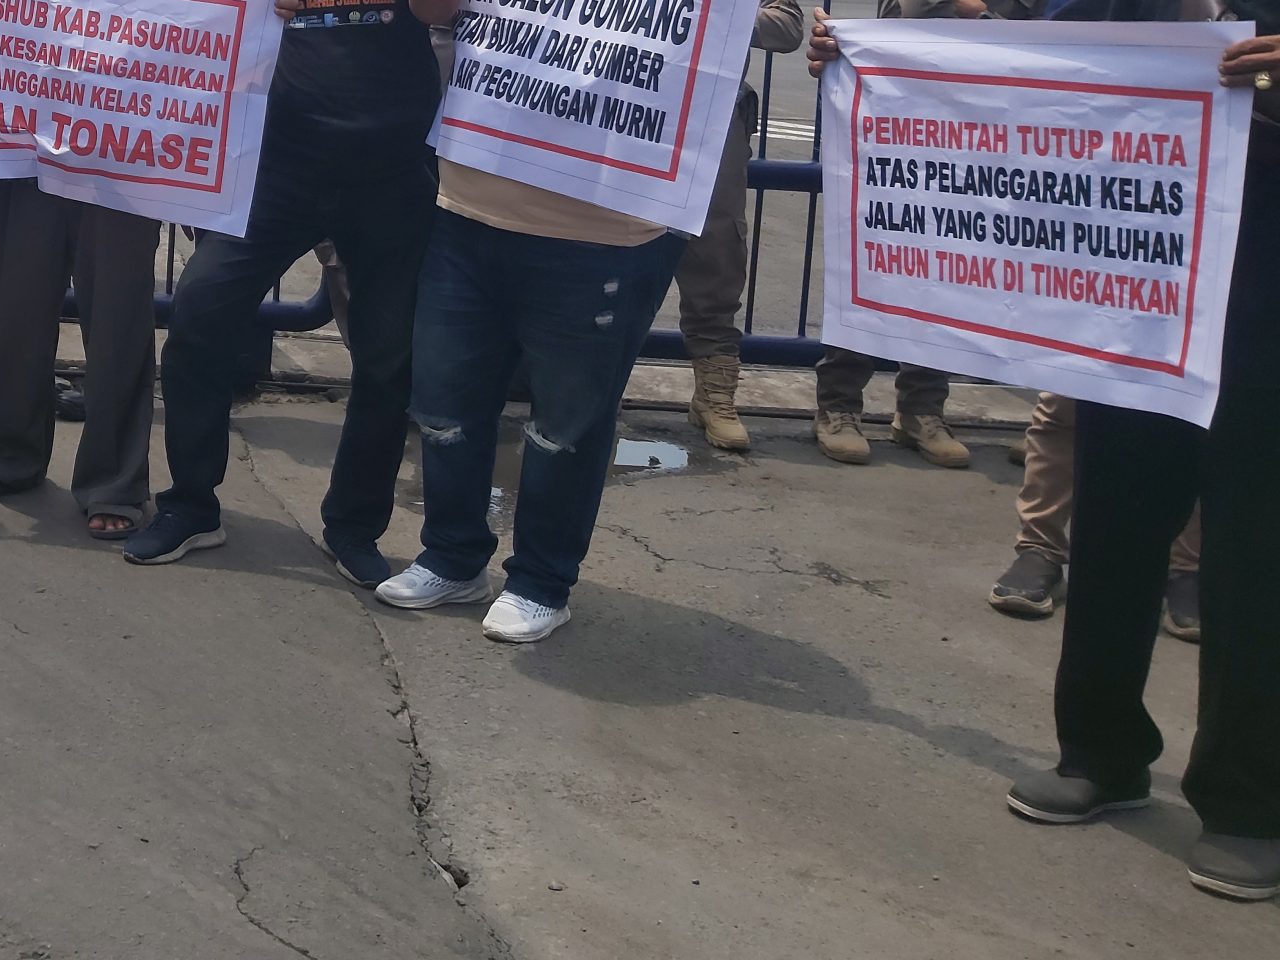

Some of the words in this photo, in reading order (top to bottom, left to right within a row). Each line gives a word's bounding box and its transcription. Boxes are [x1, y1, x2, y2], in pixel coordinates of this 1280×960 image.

[53, 4, 231, 62] KAB.PASURUAN
[454, 9, 493, 48] ETAN
[485, 16, 546, 60] BUKAN
[539, 29, 589, 72] DARI
[582, 39, 665, 93] SUMBER
[66, 47, 224, 93] MENGABAIKAN
[454, 57, 481, 91] AIR
[475, 63, 599, 126] PEGUNUNGAN
[598, 96, 667, 143] MURNI
[90, 85, 152, 118] KELAS
[156, 97, 219, 128] JALAN
[51, 111, 214, 176] TONASE
[862, 115, 1008, 154] PEMERINTAH
[1016, 125, 1104, 161] TUTUP
[1111, 130, 1187, 168] MATA
[866, 156, 919, 190] ATAS
[924, 161, 1092, 208] PELANGGARAN
[1100, 175, 1184, 217] KELAS
[864, 200, 926, 235] JALAN
[931, 206, 987, 243] YANG
[992, 213, 1066, 253] SUDAH
[1072, 221, 1184, 267] PULUHAN
[864, 240, 929, 280] TAHUN
[935, 249, 997, 290] TIDAK
[1003, 259, 1024, 293] DI
[1031, 262, 1180, 317] TINGKATKAN
